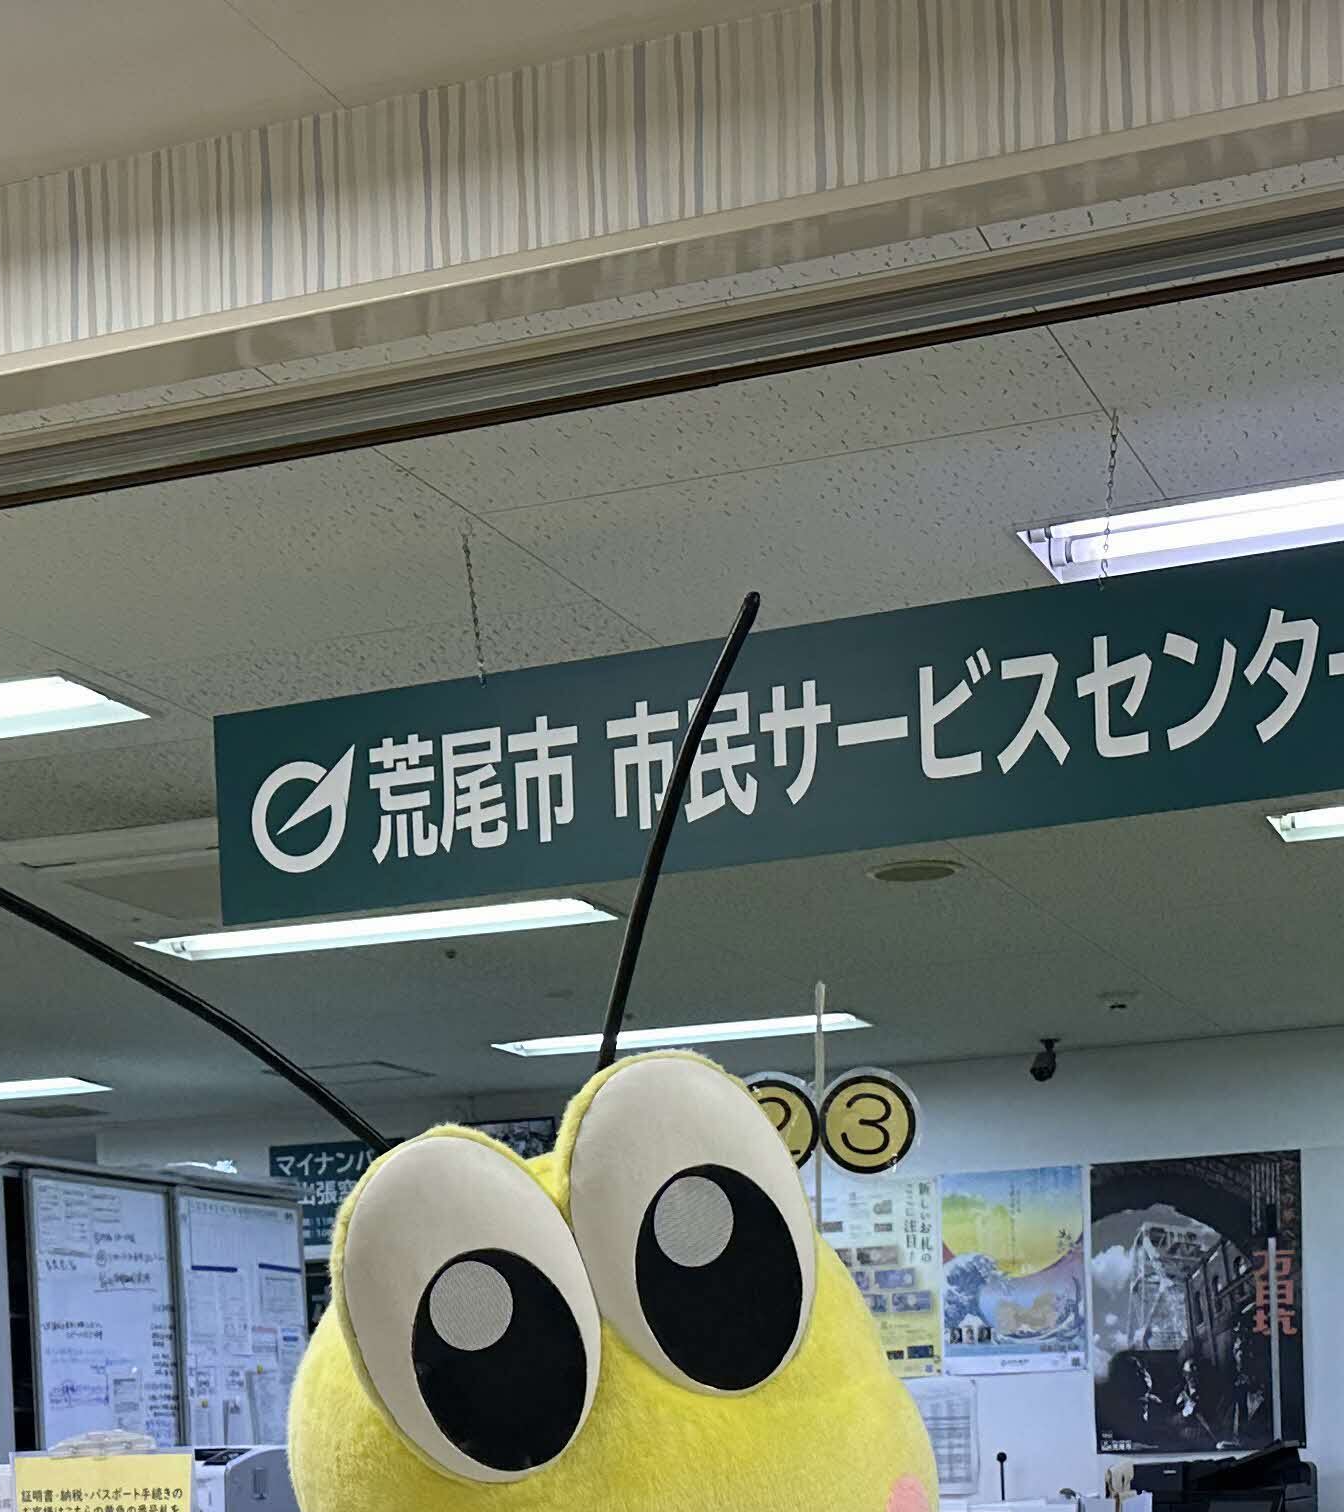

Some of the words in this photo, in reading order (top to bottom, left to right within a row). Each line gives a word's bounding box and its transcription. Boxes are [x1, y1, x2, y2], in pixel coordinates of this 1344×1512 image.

[369, 715, 578, 864] 荒尾市
[840, 1092, 892, 1155] 3
[918, 1181, 933, 1264] 新しいお札の
[20, 1487, 184, 1503] 証明書・納税・パスポート手続きの
